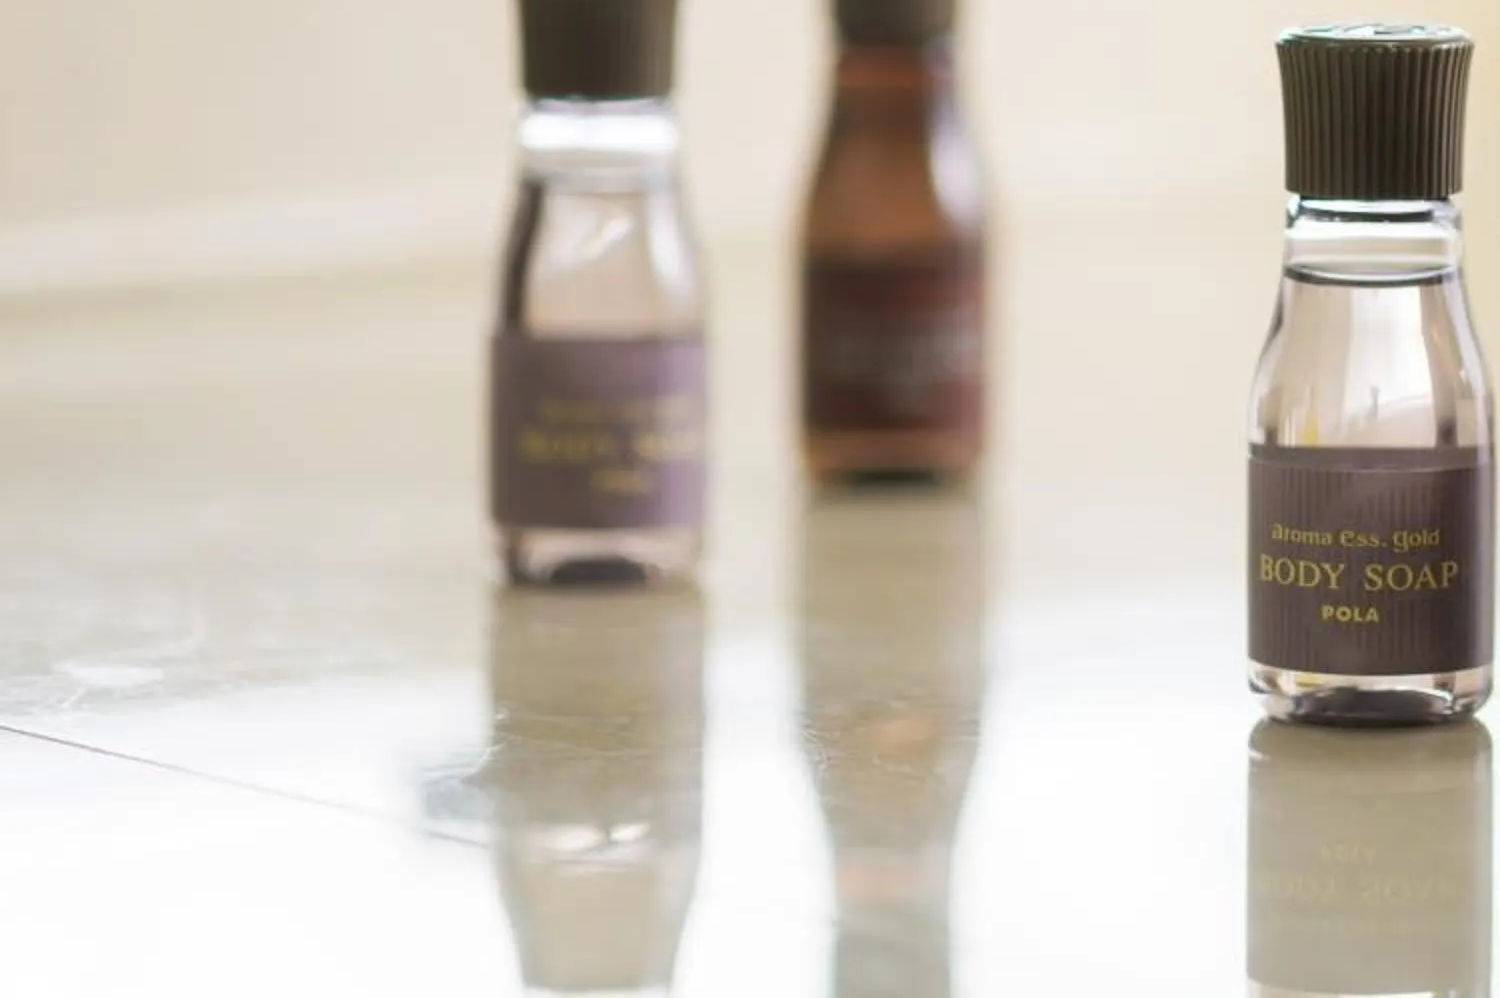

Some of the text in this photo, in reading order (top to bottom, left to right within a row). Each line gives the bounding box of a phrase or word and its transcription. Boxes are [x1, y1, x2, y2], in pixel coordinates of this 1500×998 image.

[1271, 522, 1441, 553] aroma ess. gold
[1260, 553, 1460, 592] BODY SOAP
[1320, 604, 1380, 623] POLA
